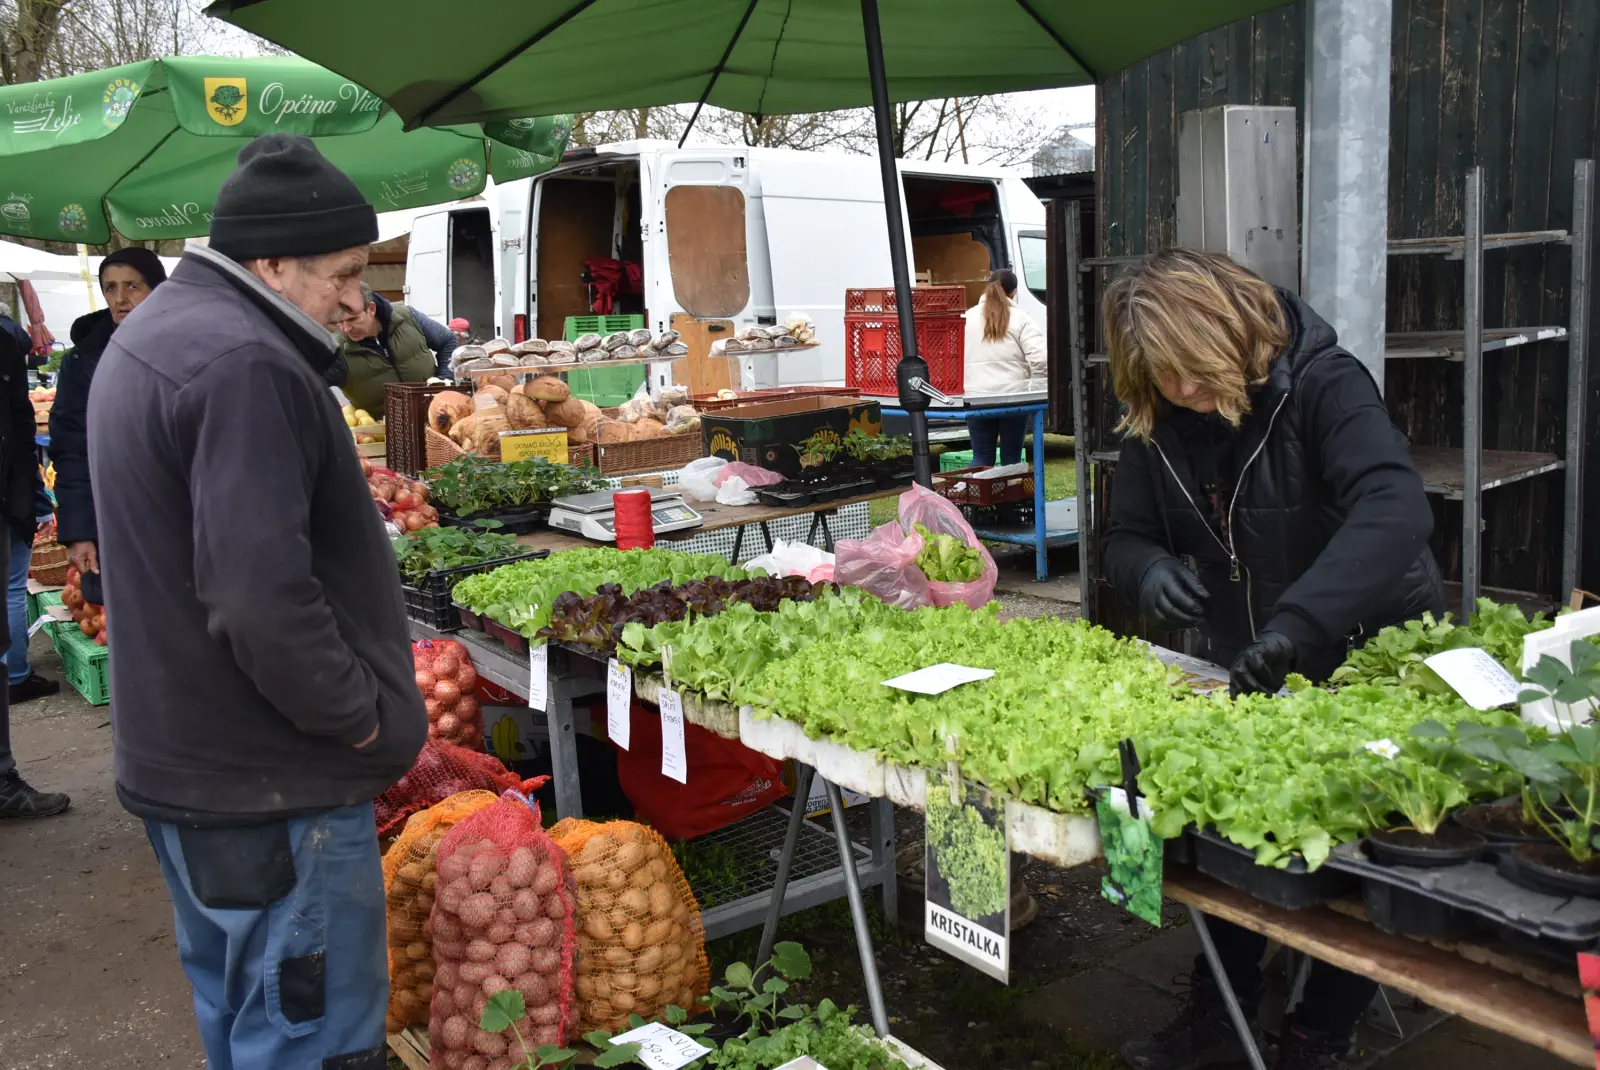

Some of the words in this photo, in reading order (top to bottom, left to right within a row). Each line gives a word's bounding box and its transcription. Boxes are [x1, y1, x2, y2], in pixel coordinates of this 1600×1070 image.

[39, 95, 82, 138] Zelje
[259, 82, 337, 124] Općina
[931, 910, 1000, 959] KRISTALKA
